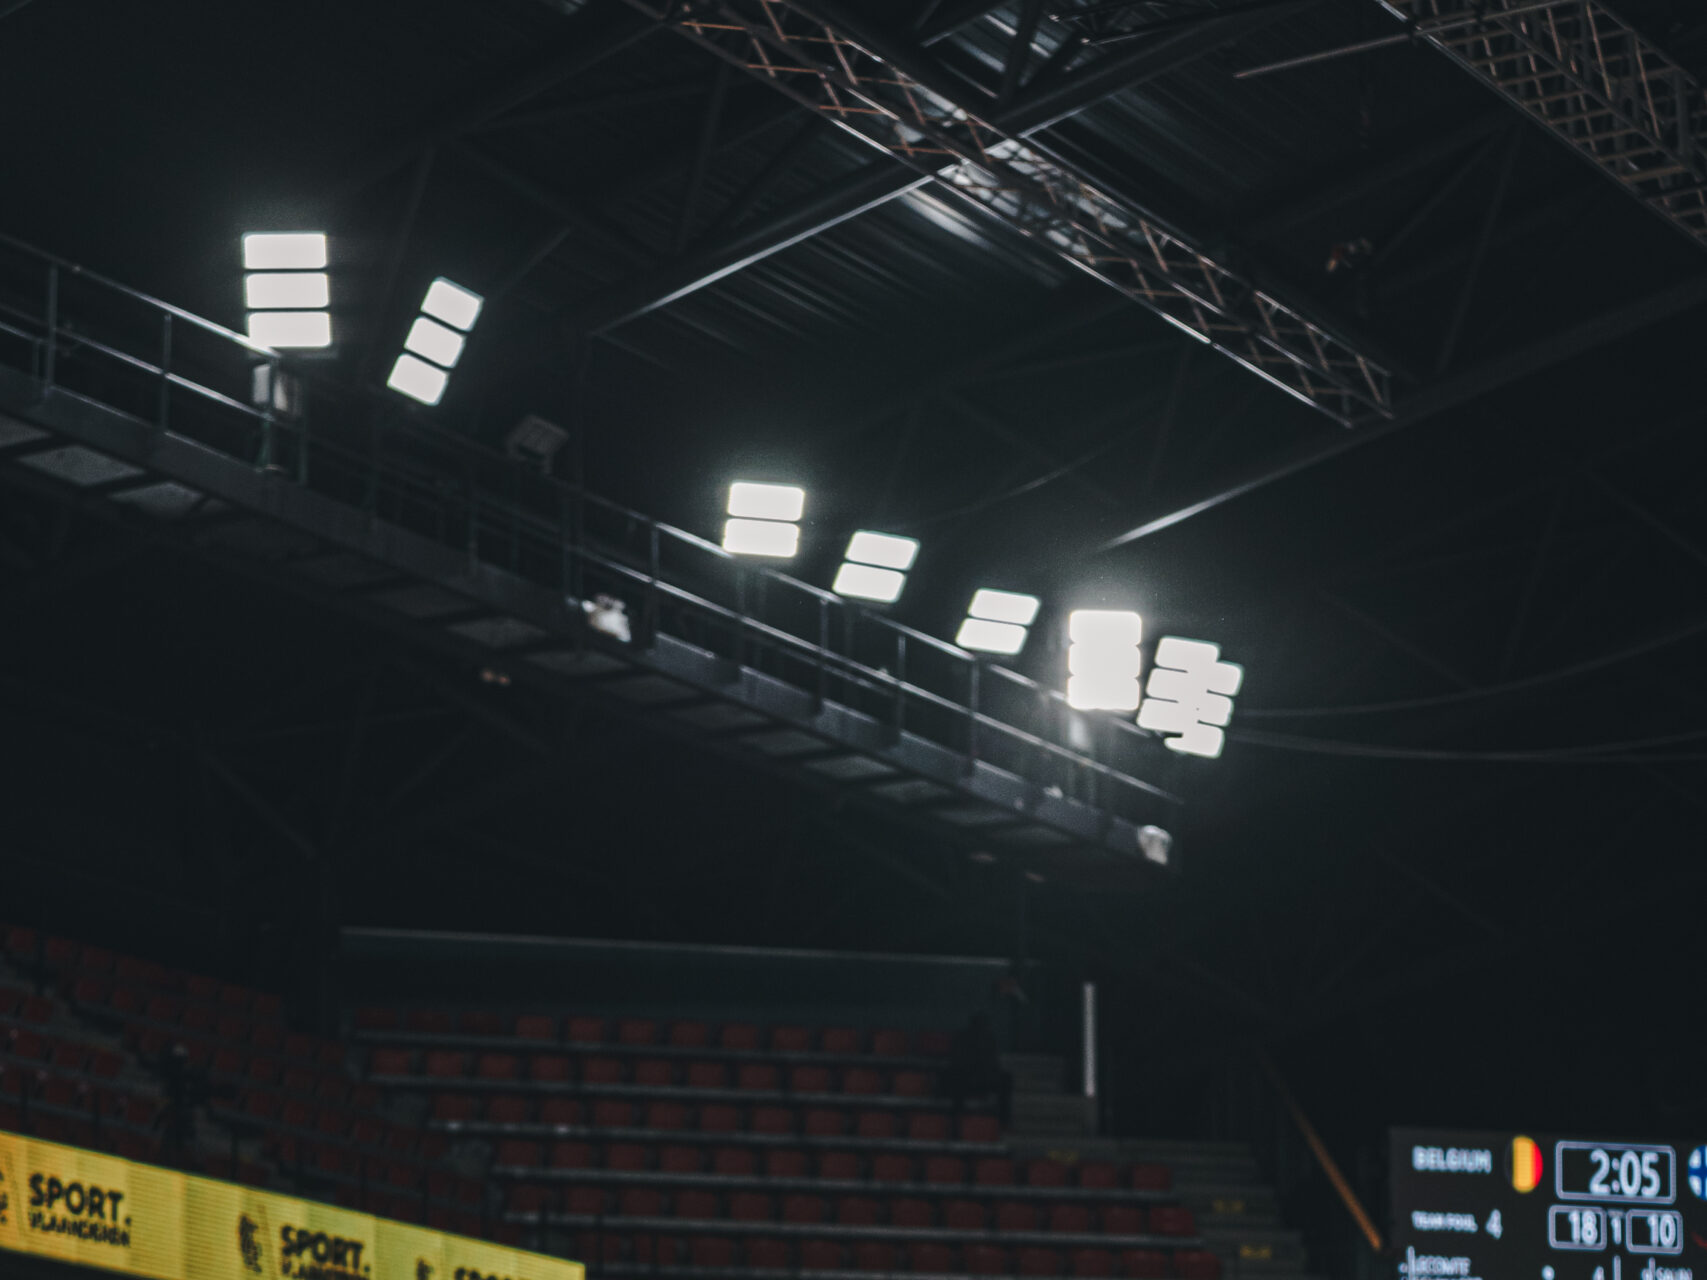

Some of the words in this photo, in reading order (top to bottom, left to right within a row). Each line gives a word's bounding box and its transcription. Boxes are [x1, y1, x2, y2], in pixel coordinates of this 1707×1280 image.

[1413, 1147, 1492, 1173] BELGIUM
[1589, 1149, 1661, 1197] 2:05
[1568, 1210, 1597, 1245] 18
[1647, 1213, 1677, 1247] 10
